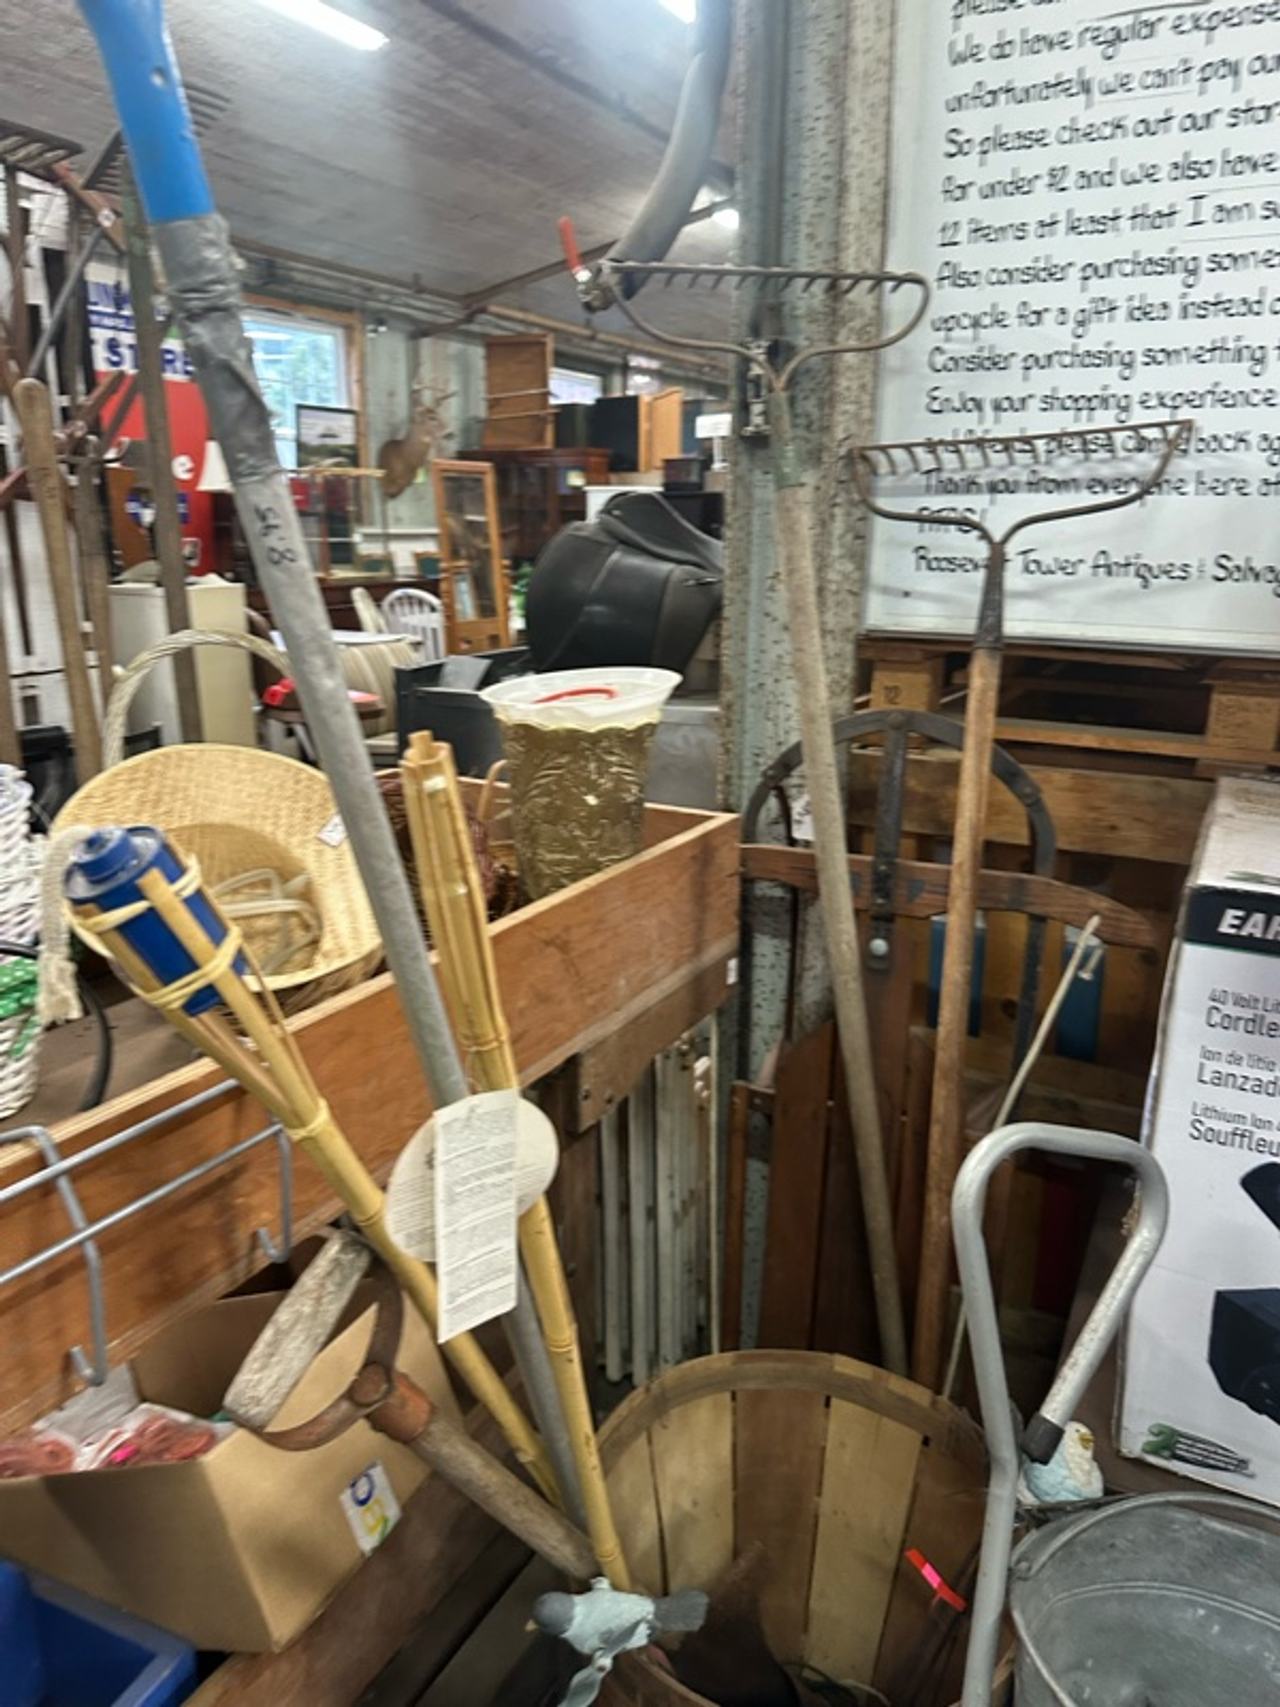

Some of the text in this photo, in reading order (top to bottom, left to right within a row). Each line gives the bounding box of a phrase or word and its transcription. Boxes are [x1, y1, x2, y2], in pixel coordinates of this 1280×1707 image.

[948, 33, 985, 66] We
[988, 29, 1017, 60] do
[1018, 27, 1074, 57] have
[1077, 15, 1166, 60] regular
[945, 66, 1095, 113] unfortunately
[1097, 72, 1135, 95] we
[1197, 57, 1244, 97] pay
[1247, 53, 1280, 76] ou
[943, 98, 1280, 167] So please check out our stor
[942, 147, 1280, 202] for under $2 and we also have
[937, 220, 962, 247] 12
[966, 217, 1031, 245] items
[1034, 212, 1062, 239] at
[1065, 206, 1123, 236] least
[1127, 202, 1181, 232] that
[1185, 195, 1210, 227] I
[1212, 202, 1256, 224] am
[935, 247, 1280, 293] Also consider purchasing some
[931, 302, 1009, 342] upcycle
[1017, 300, 1051, 327] for
[1054, 306, 1070, 326] a
[1072, 296, 1120, 339] gift
[1125, 293, 1169, 322] idea
[1177, 286, 1267, 320] instead
[927, 344, 1018, 372] Consider
[1022, 340, 1136, 382] purchasing
[1141, 335, 1267, 377] something
[925, 381, 1280, 425] Enjoy your shopping experience
[1195, 426, 1252, 453] back
[920, 468, 980, 495] Thank
[987, 478, 1021, 506] you
[1026, 469, 1082, 494] from
[1195, 469, 1252, 496] here
[1016, 548, 1085, 575] Tower
[1090, 550, 1193, 589] Antiques
[1206, 1005, 1280, 1038] Cordle
[1225, 1050, 1244, 1067] de
[1191, 1102, 1274, 1130] Lithium Ion
